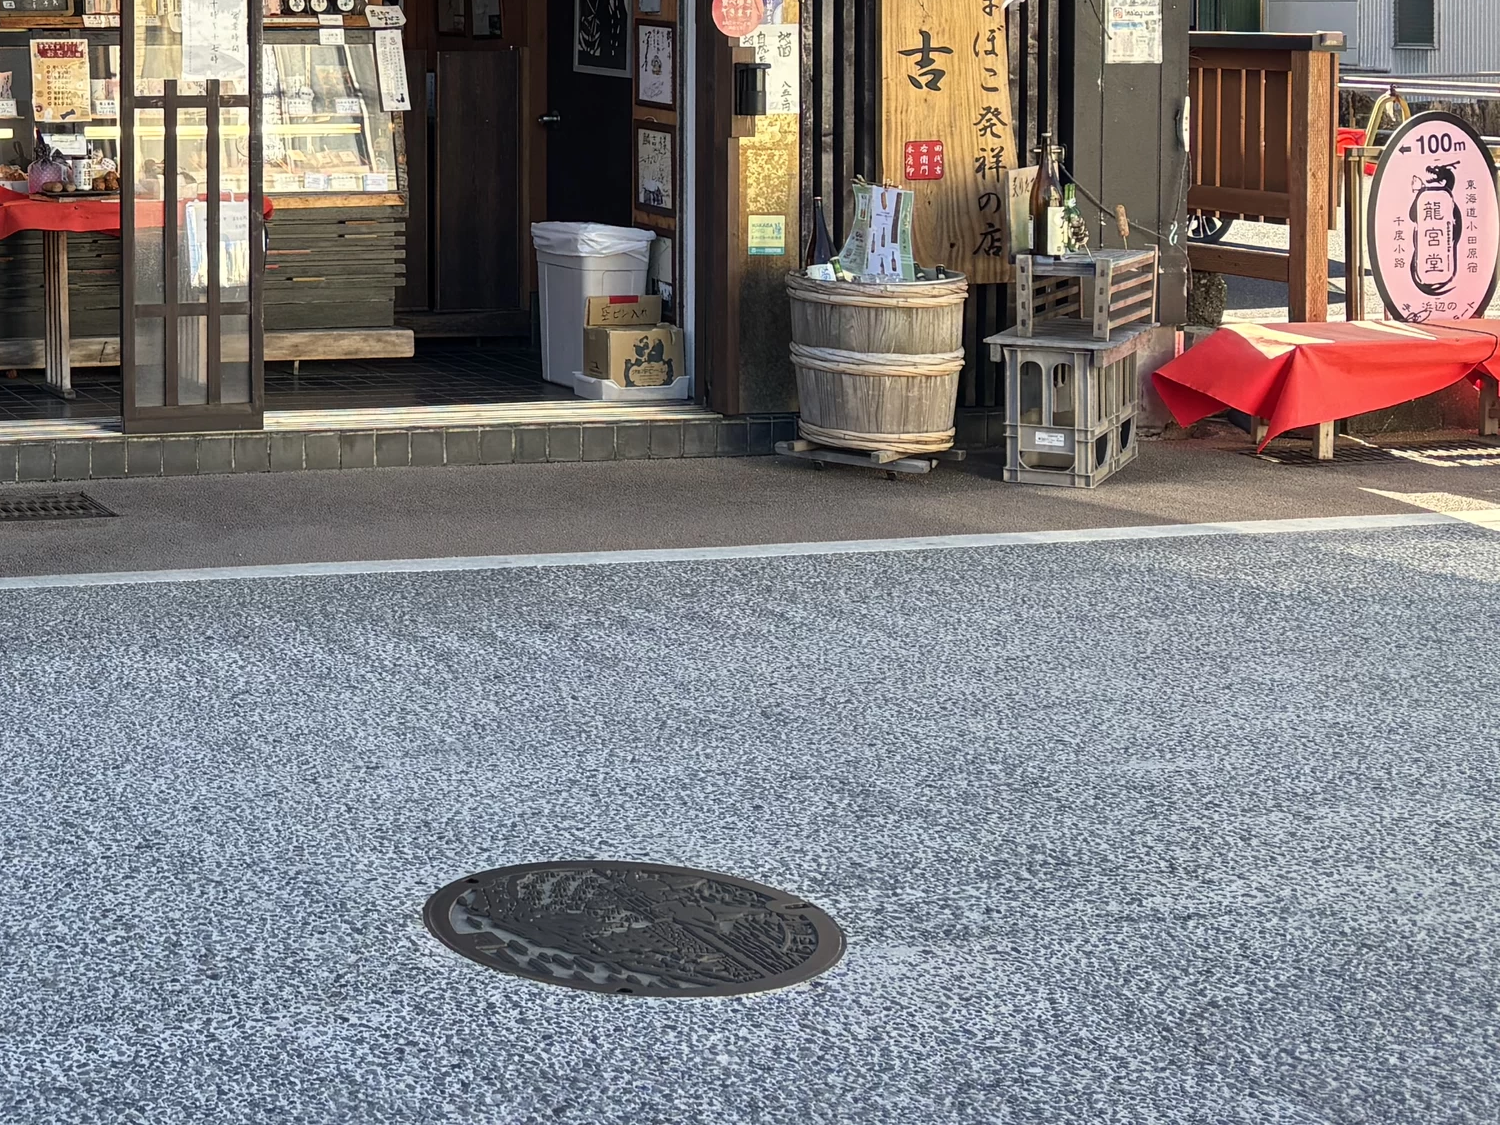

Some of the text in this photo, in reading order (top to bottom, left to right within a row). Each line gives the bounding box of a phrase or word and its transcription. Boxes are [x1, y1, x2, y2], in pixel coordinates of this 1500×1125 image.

[1124, 8, 1155, 18] Instagram
[1415, 132, 1466, 155] 100m
[1393, 217, 1406, 269] 千度小路
[1423, 201, 1444, 273] 龍宮堂
[1465, 179, 1478, 273] 東海道小田原宿
[601, 305, 648, 321] 空ビン入れ
